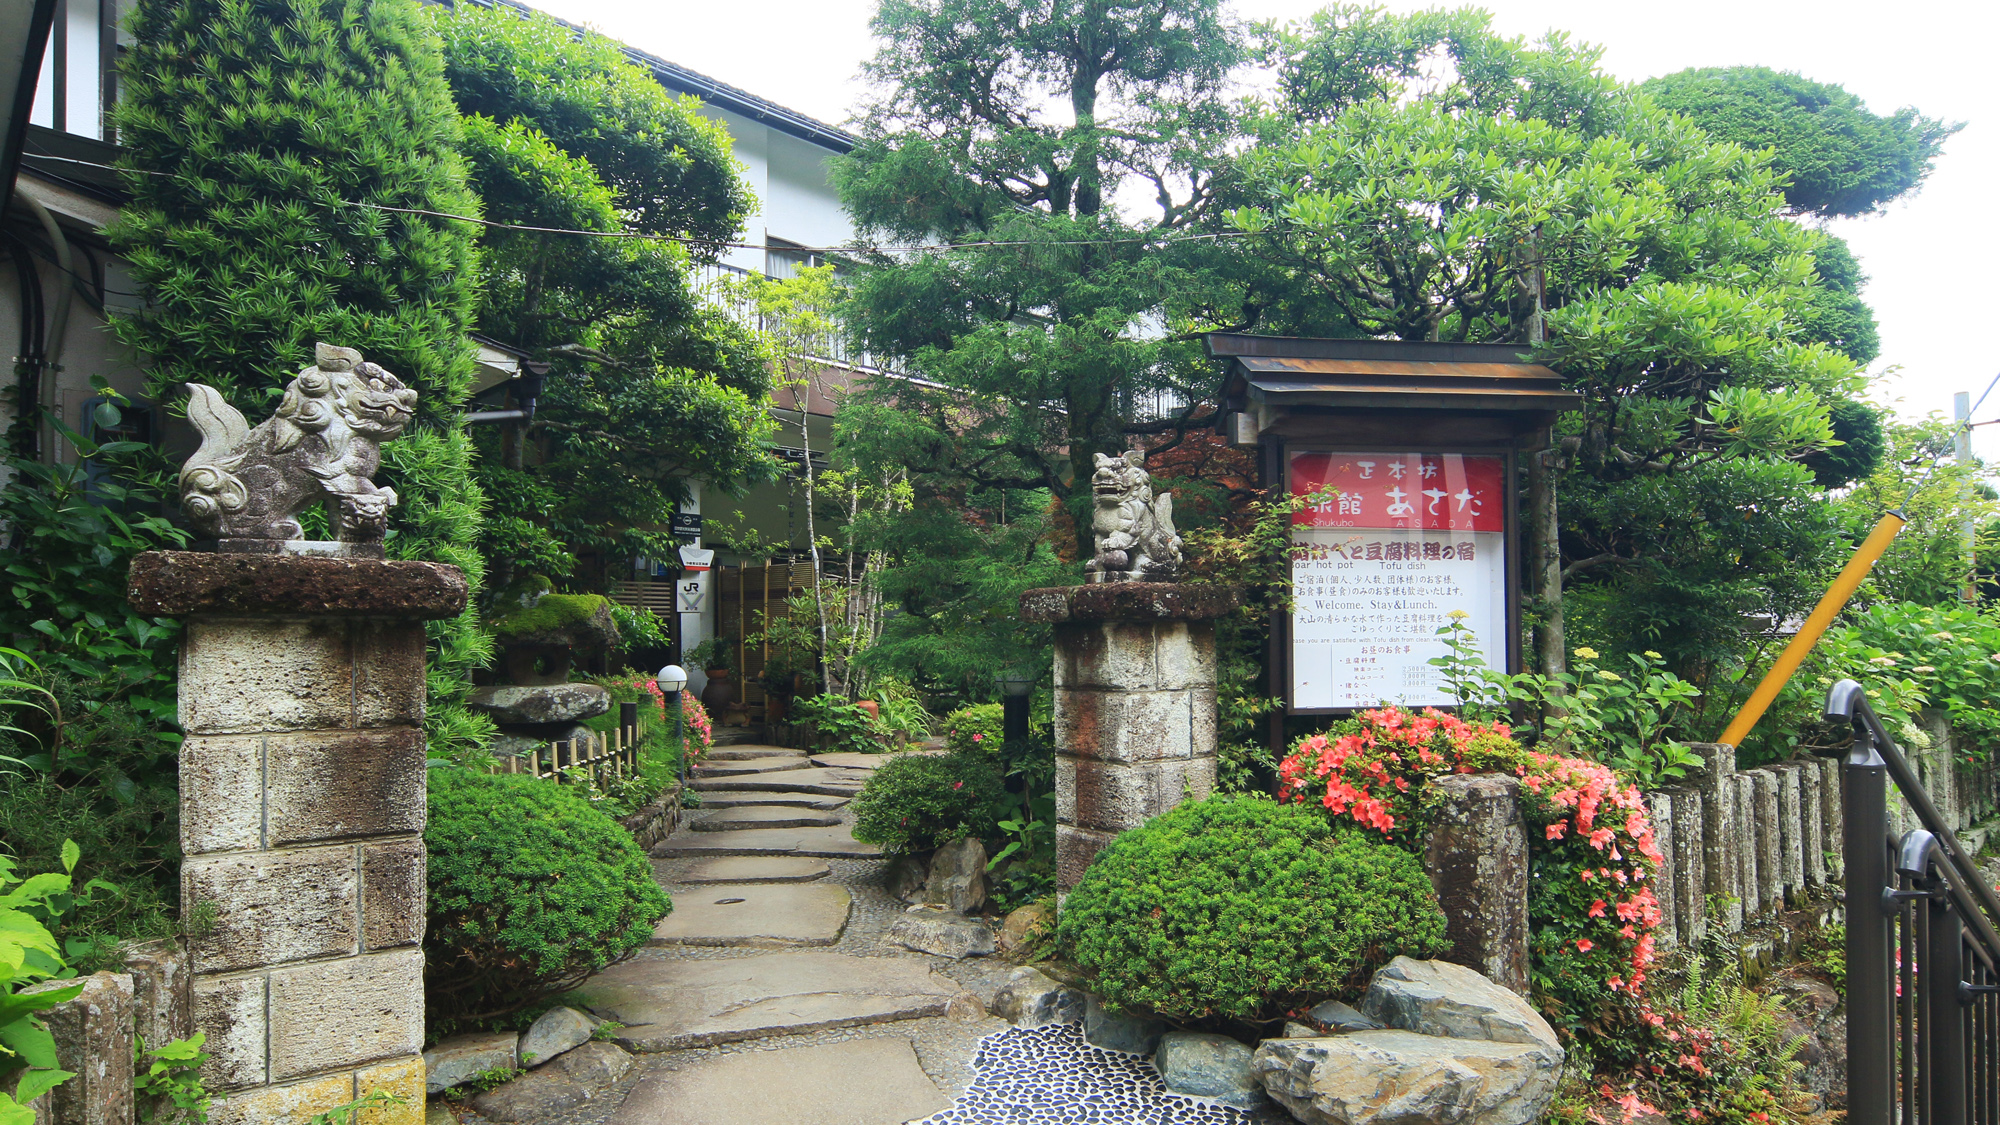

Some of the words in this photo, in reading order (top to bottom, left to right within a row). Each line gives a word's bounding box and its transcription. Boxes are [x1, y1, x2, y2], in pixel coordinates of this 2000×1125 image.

[1385, 486, 1484, 517] あさだ
[1312, 517, 1355, 527] Shukubo
[1396, 518, 1474, 529] ASADA
[1292, 561, 1310, 570] oar
[1316, 560, 1333, 569] hot
[1337, 561, 1354, 571] pot
[1379, 561, 1402, 570] Tofu
[1407, 561, 1426, 570] dish
[683, 582, 699, 592] JR
[1315, 599, 1364, 610] Welcome.
[1369, 599, 1438, 611] Stay&Lunch.
